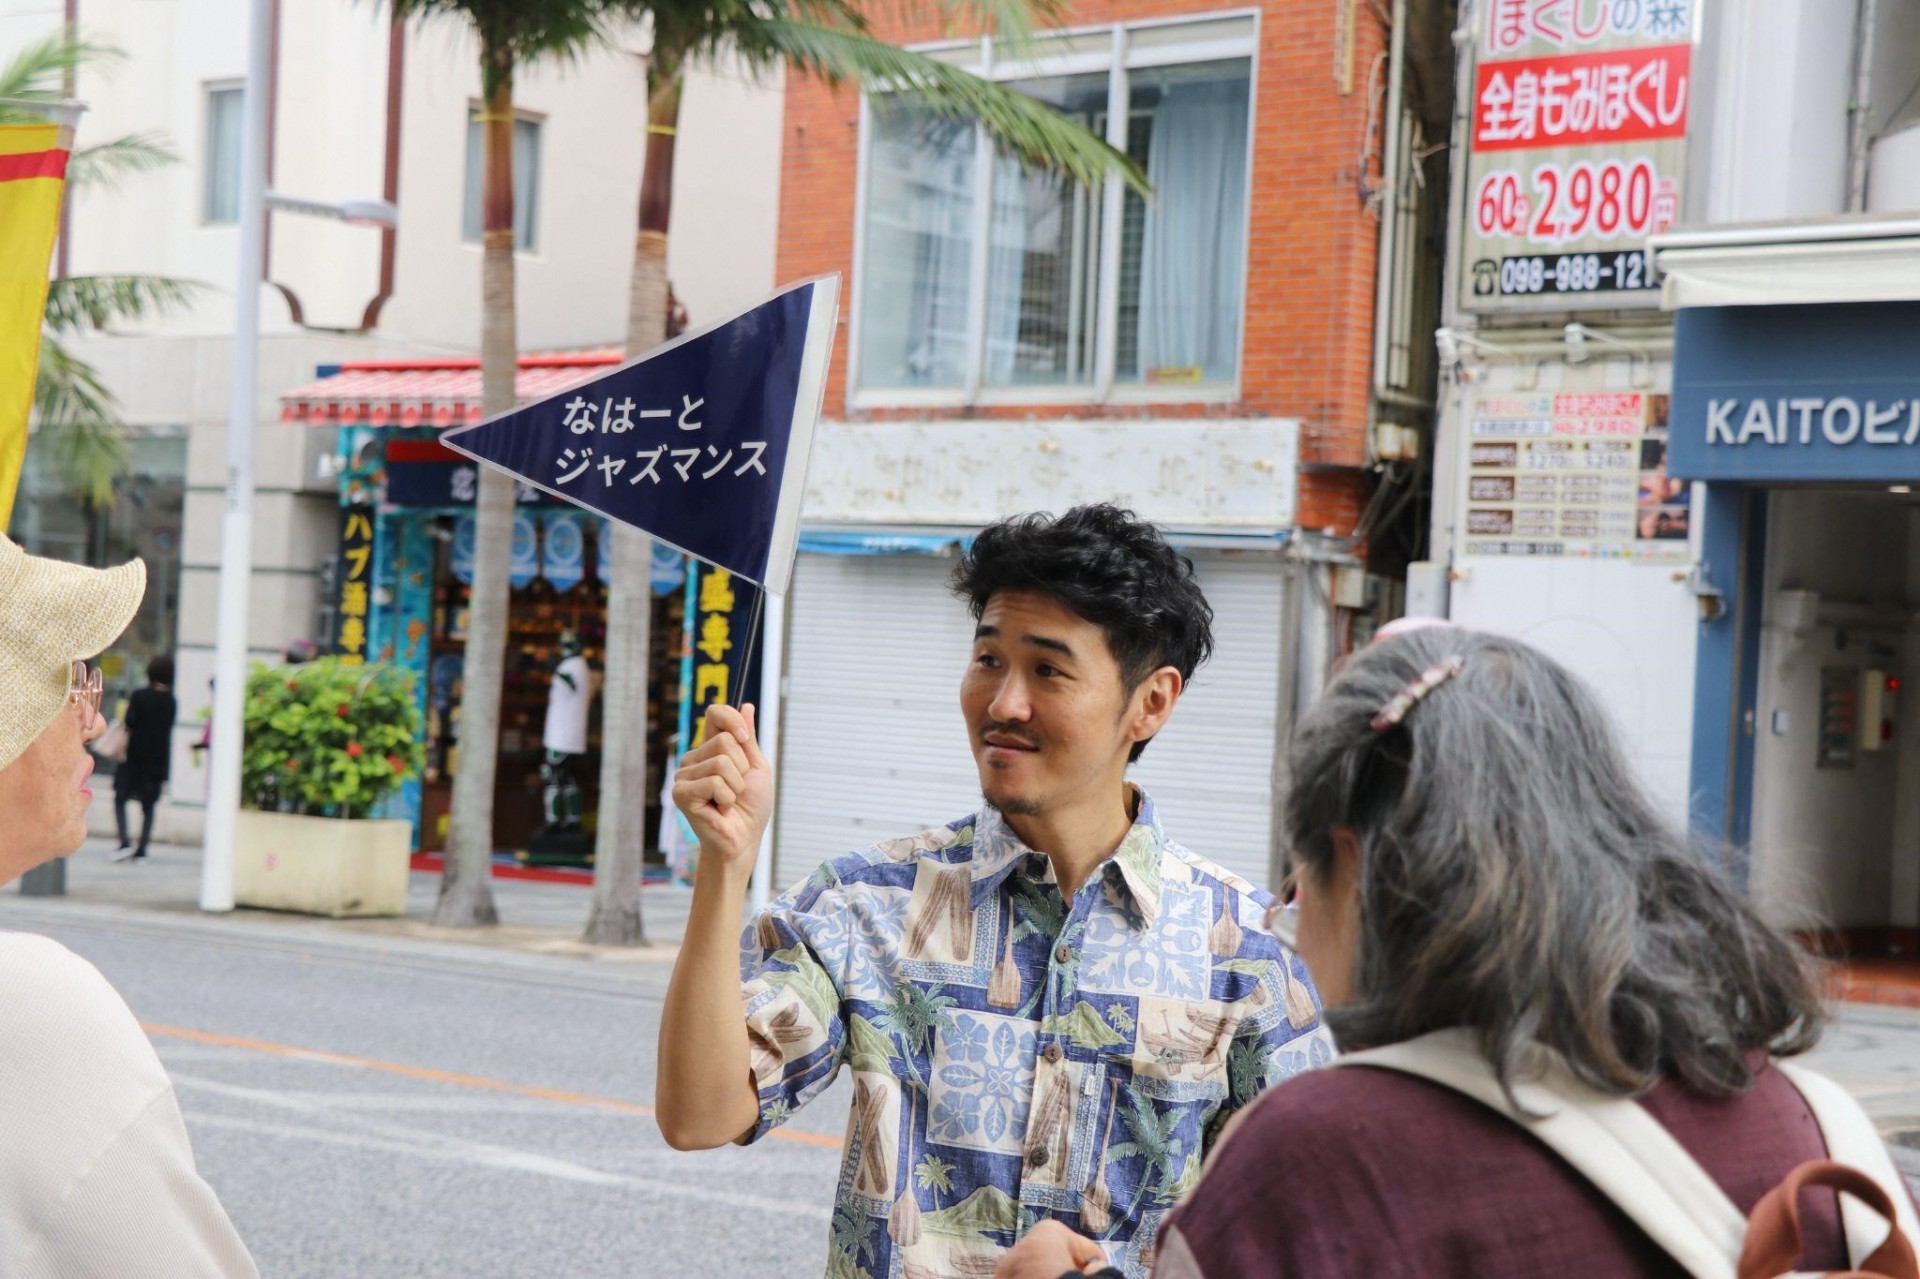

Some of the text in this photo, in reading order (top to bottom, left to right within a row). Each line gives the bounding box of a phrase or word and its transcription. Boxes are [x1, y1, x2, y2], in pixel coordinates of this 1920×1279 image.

[1478, 58, 1688, 142] 全身もみほぐし
[561, 393, 705, 435] なはーと
[554, 440, 768, 488] ジャズマンス
[339, 513, 373, 666] ハブ酒専
[691, 566, 736, 750] 盛専門
